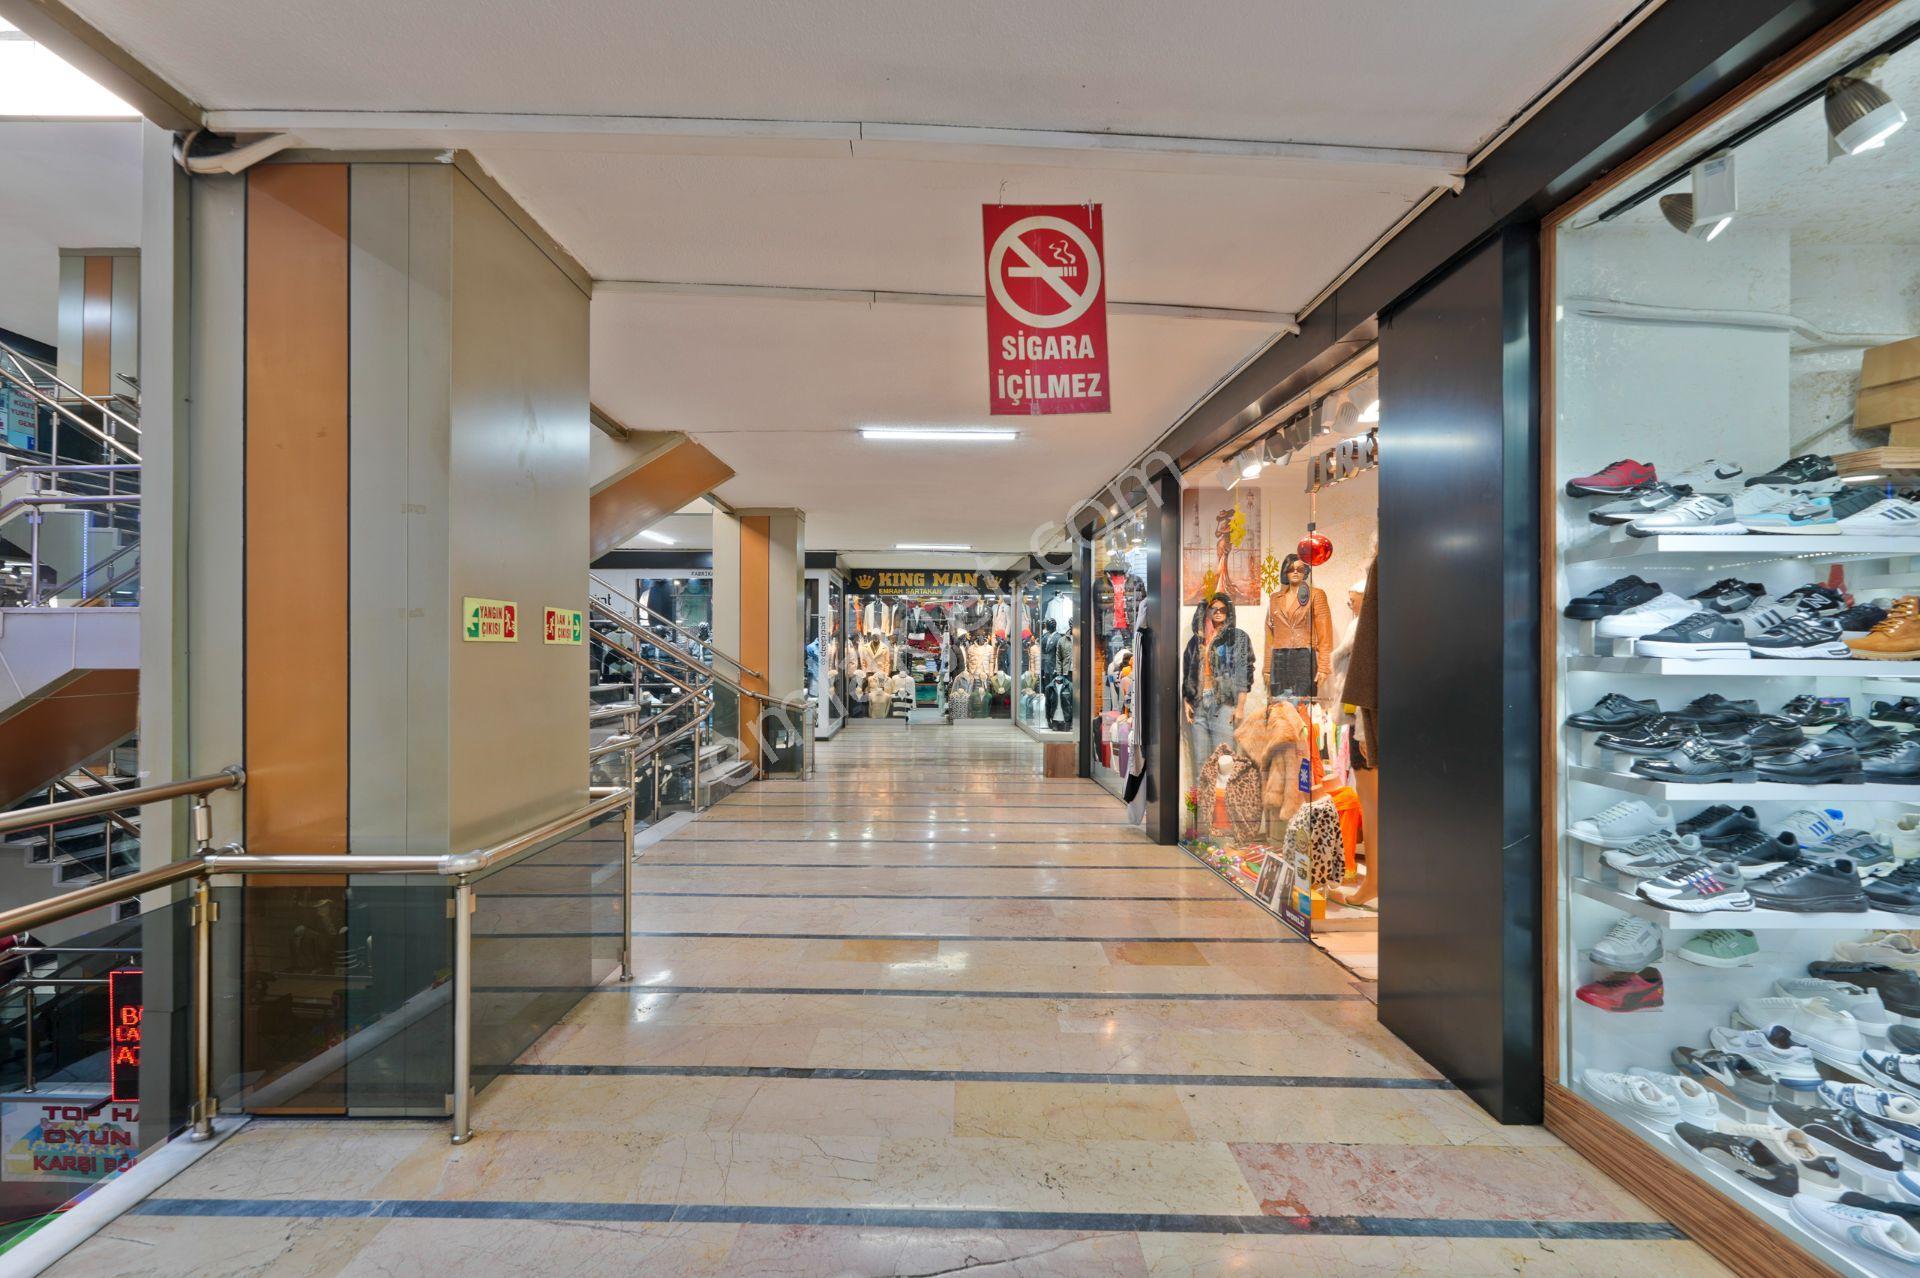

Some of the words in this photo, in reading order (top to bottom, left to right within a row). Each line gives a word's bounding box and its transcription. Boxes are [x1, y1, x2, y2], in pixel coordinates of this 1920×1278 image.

[1001, 330, 1095, 361] SİGARA
[998, 369, 1102, 406] İÇİLMEZ
[878, 572, 925, 587] KING
[932, 573, 979, 587] MAN
[479, 605, 503, 619] YANGIN
[42, 1105, 101, 1121] TOP
[43, 1129, 132, 1145] OYUN
[34, 1154, 97, 1174] KARŞI
